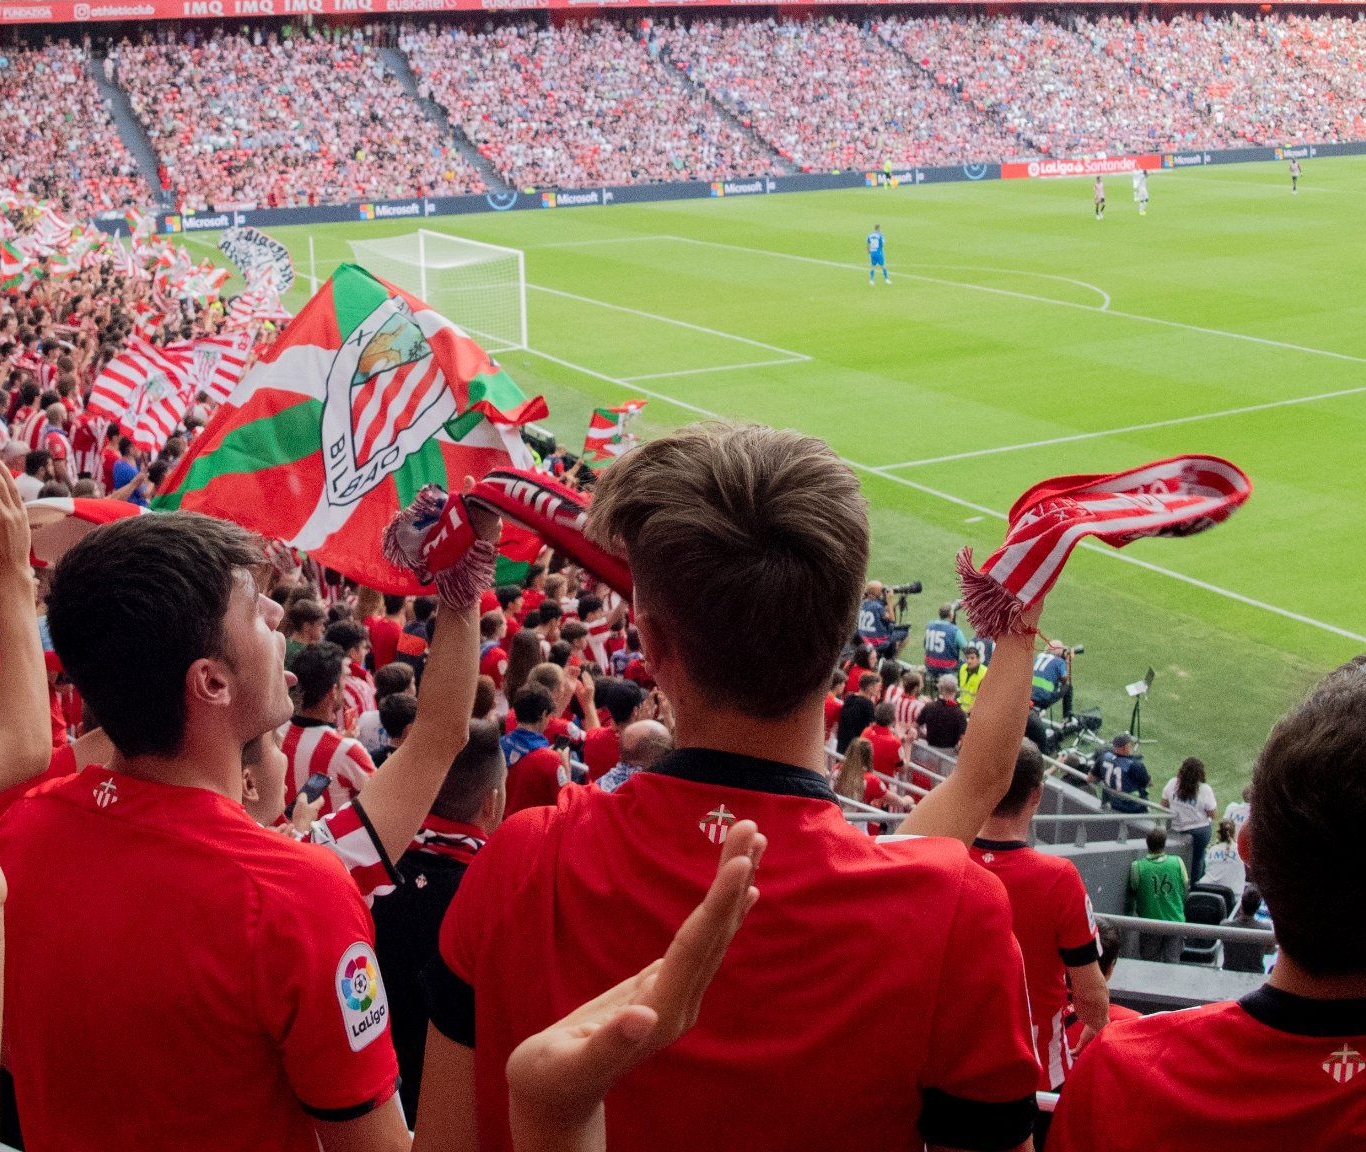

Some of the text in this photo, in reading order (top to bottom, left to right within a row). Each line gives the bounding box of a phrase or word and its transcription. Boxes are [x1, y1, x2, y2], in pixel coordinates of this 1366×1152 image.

[183, 1, 223, 17] IMQ
[235, 0, 274, 15] IMQ
[1041, 156, 1137, 175] LaLiga Santander
[724, 180, 762, 194] Microsoft
[556, 193, 597, 205] Microsoft
[375, 203, 418, 217] Microsoft
[182, 212, 229, 229] Microsoft
[330, 432, 400, 498] BILBAO
[1102, 760, 1122, 792] 71
[352, 1004, 385, 1038] LaLiga
